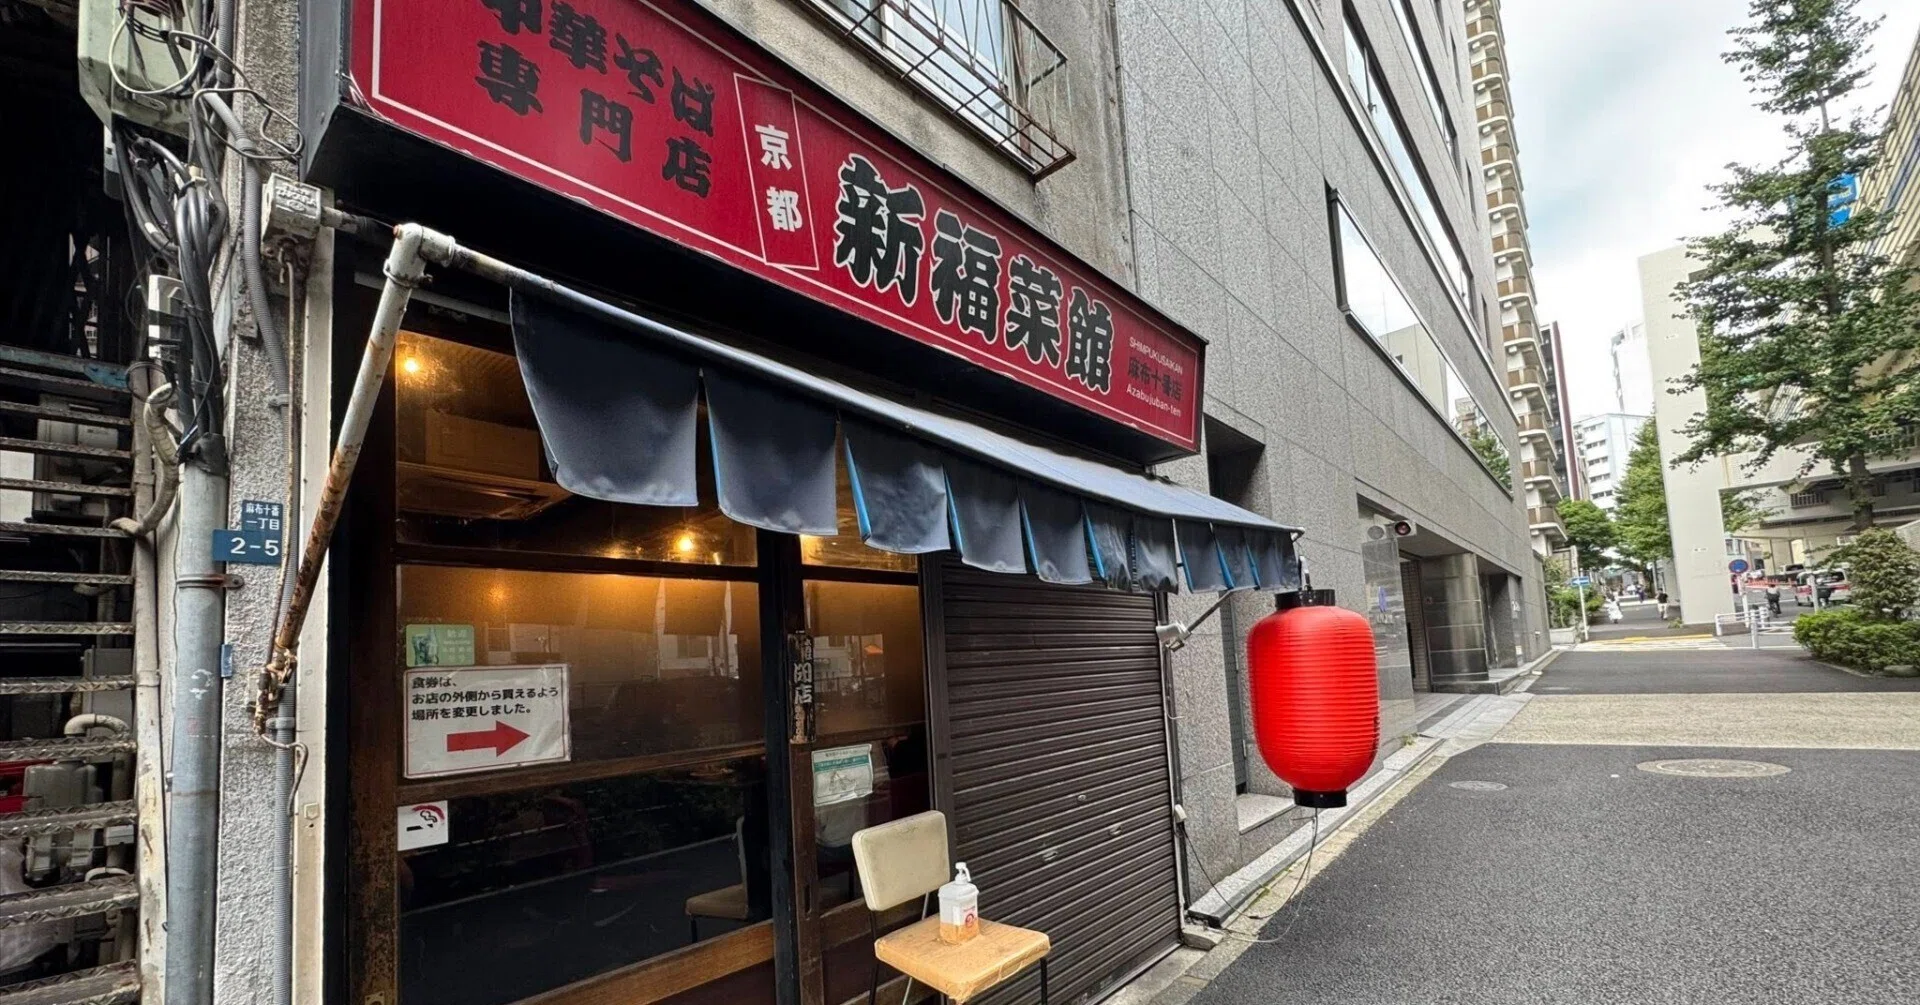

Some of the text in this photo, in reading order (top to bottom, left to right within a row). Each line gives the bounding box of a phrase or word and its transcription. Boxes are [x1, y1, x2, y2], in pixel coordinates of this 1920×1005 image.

[755, 124, 803, 232] 京都
[833, 153, 1114, 396] 新福菜館
[245, 502, 280, 516] 麻布十番
[245, 517, 280, 530] 一丁目
[411, 676, 458, 690] 食券は、
[412, 687, 559, 704] お店の外側から買えるよう
[411, 703, 531, 721] 場所を変更しました。
